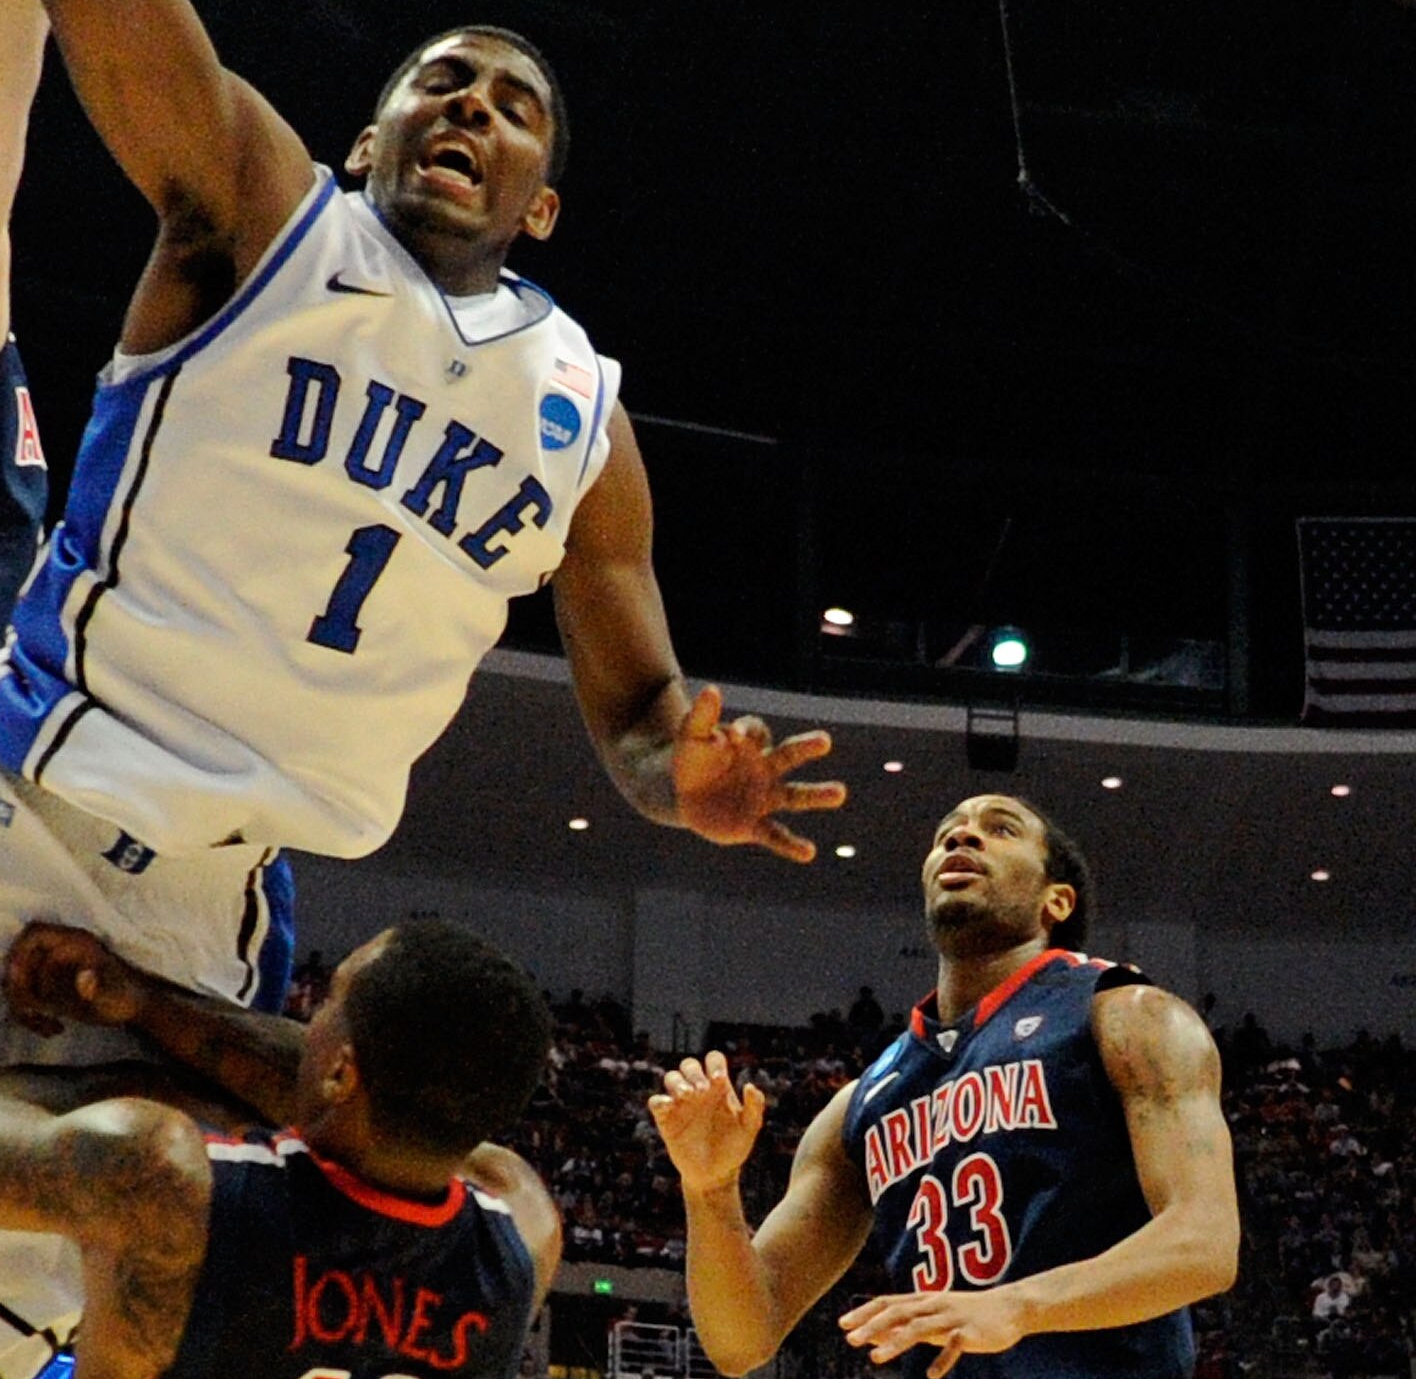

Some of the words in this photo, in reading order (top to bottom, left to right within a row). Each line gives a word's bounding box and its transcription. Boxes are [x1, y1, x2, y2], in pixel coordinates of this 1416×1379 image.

[271, 356, 555, 570] DUKE
[306, 522, 402, 655] 1
[865, 1059, 1058, 1206] ARIZONA
[906, 1151, 1012, 1293] 33
[289, 1253, 491, 1371] JONES
